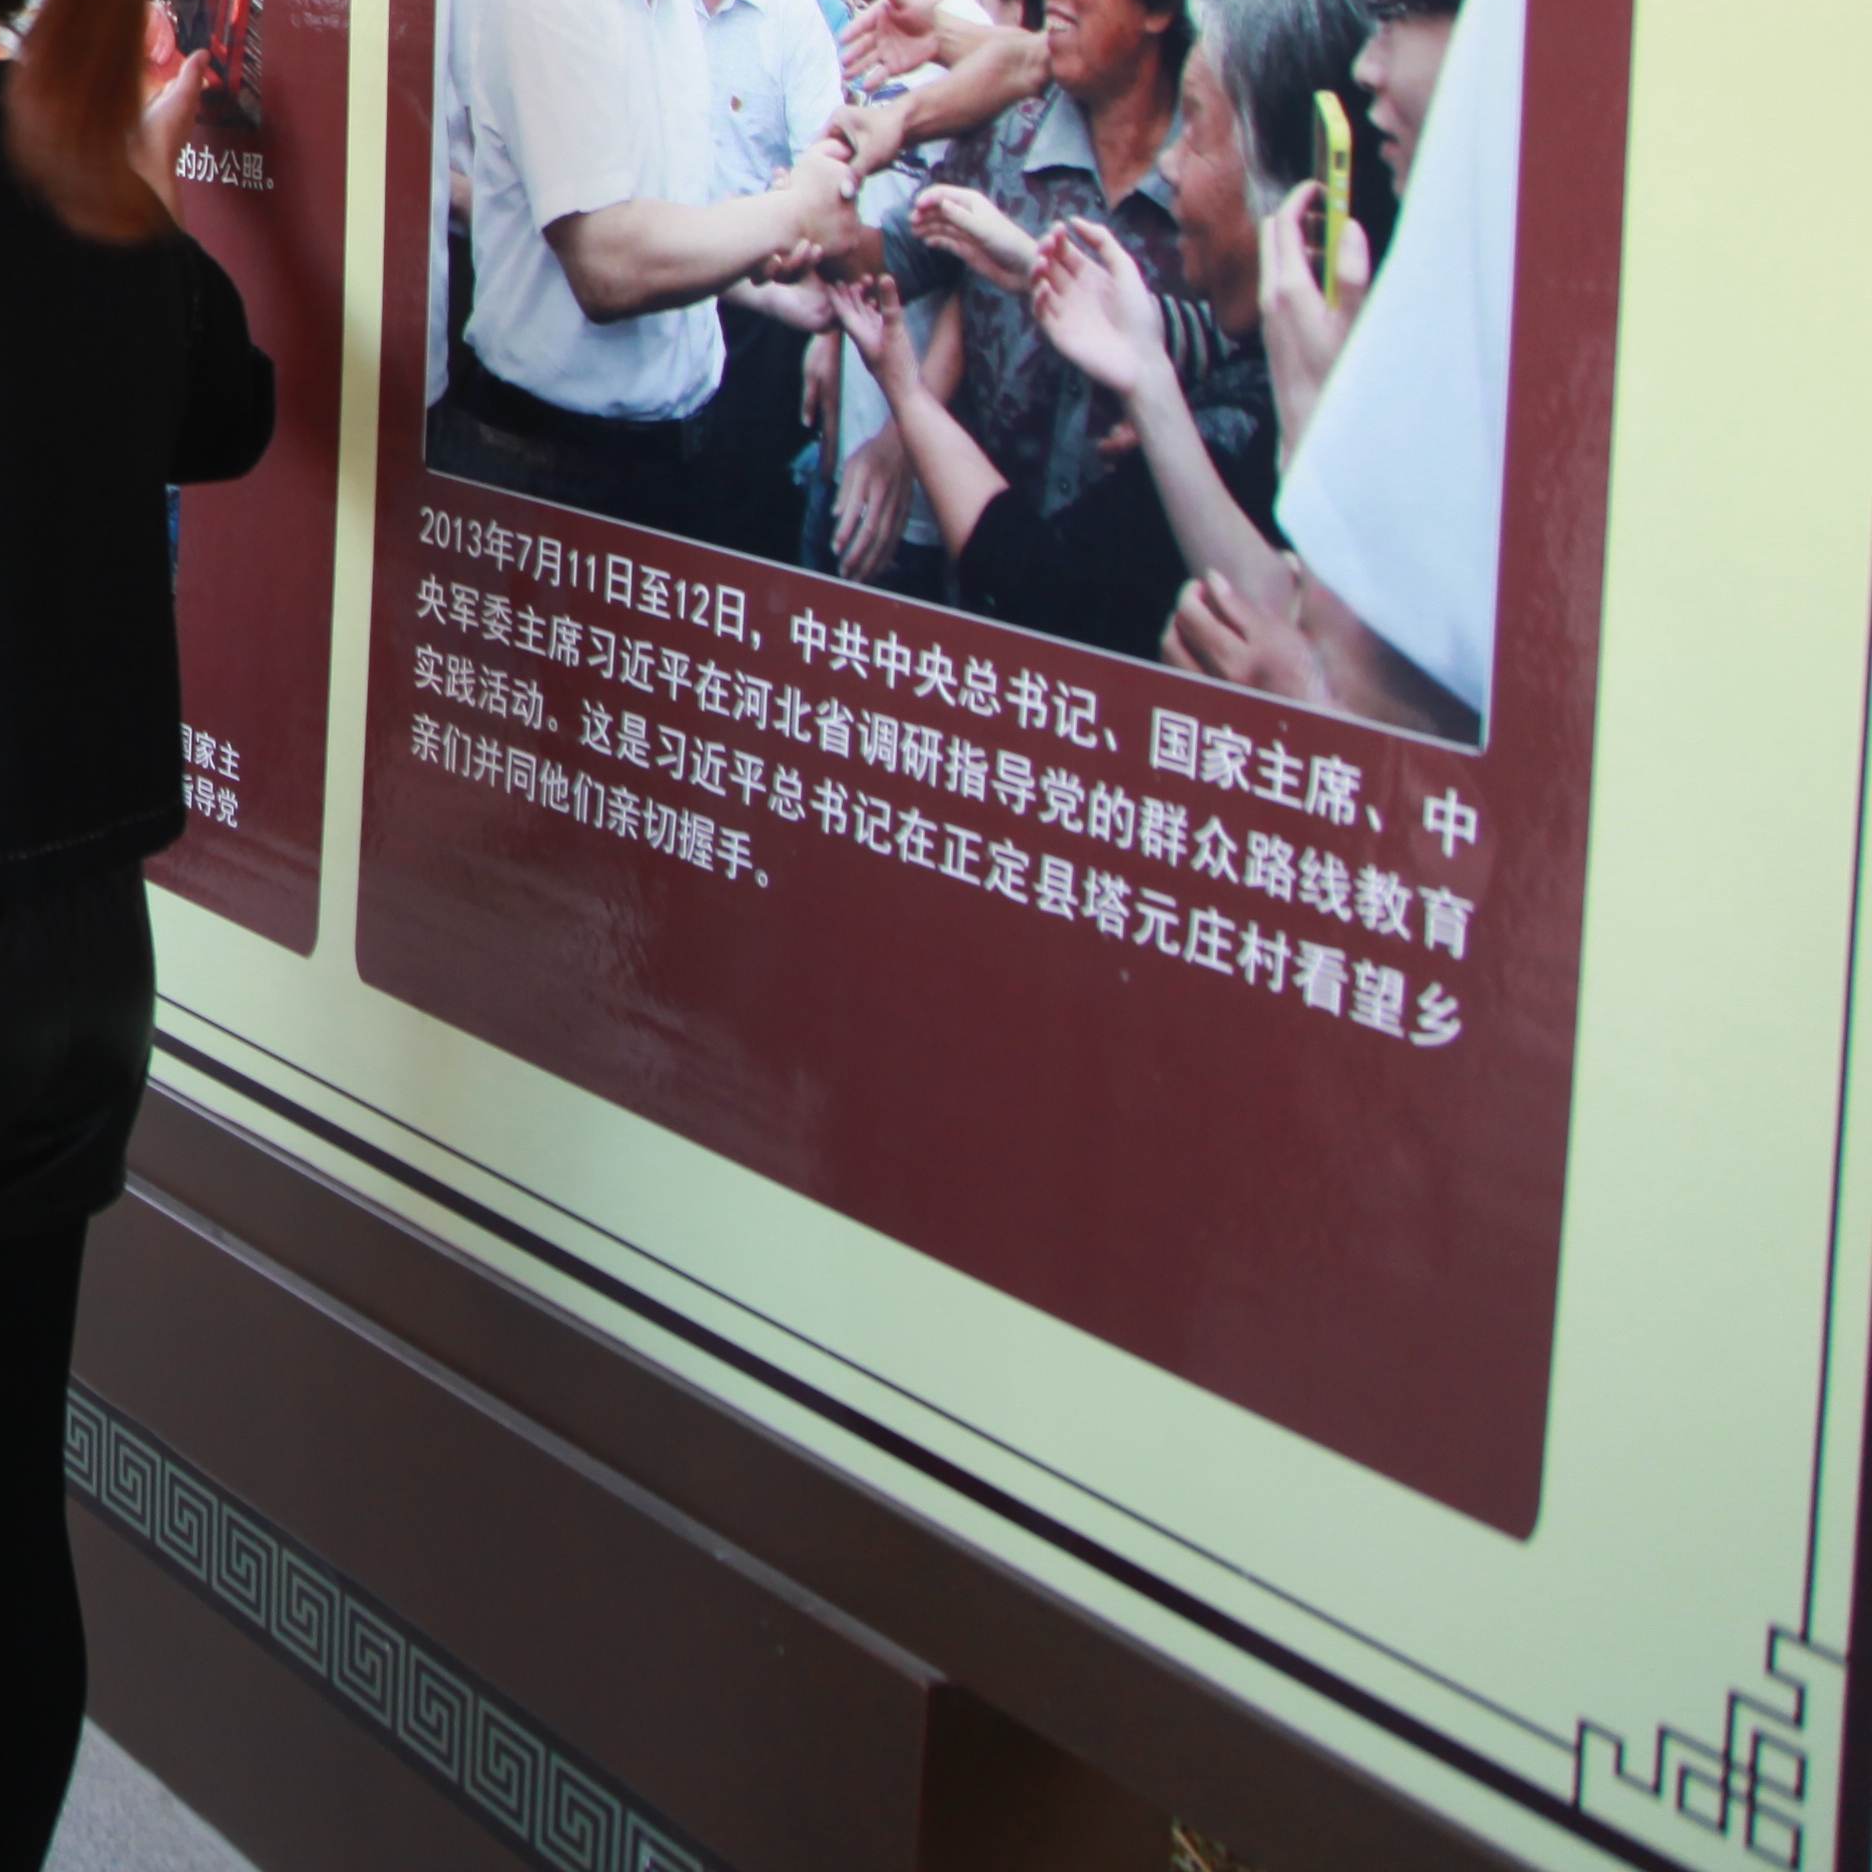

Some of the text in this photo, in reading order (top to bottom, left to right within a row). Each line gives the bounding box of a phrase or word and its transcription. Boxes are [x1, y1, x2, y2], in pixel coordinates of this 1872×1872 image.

[410, 712, 768, 888] 亲们并同他们亲切握手。
[412, 644, 1462, 1049] 实践活动。这是习近平总书记在正定县塔元庄村看望乡
[416, 574, 1473, 960] 央军委主席习近平在河北省调研指导党的群众路线教育
